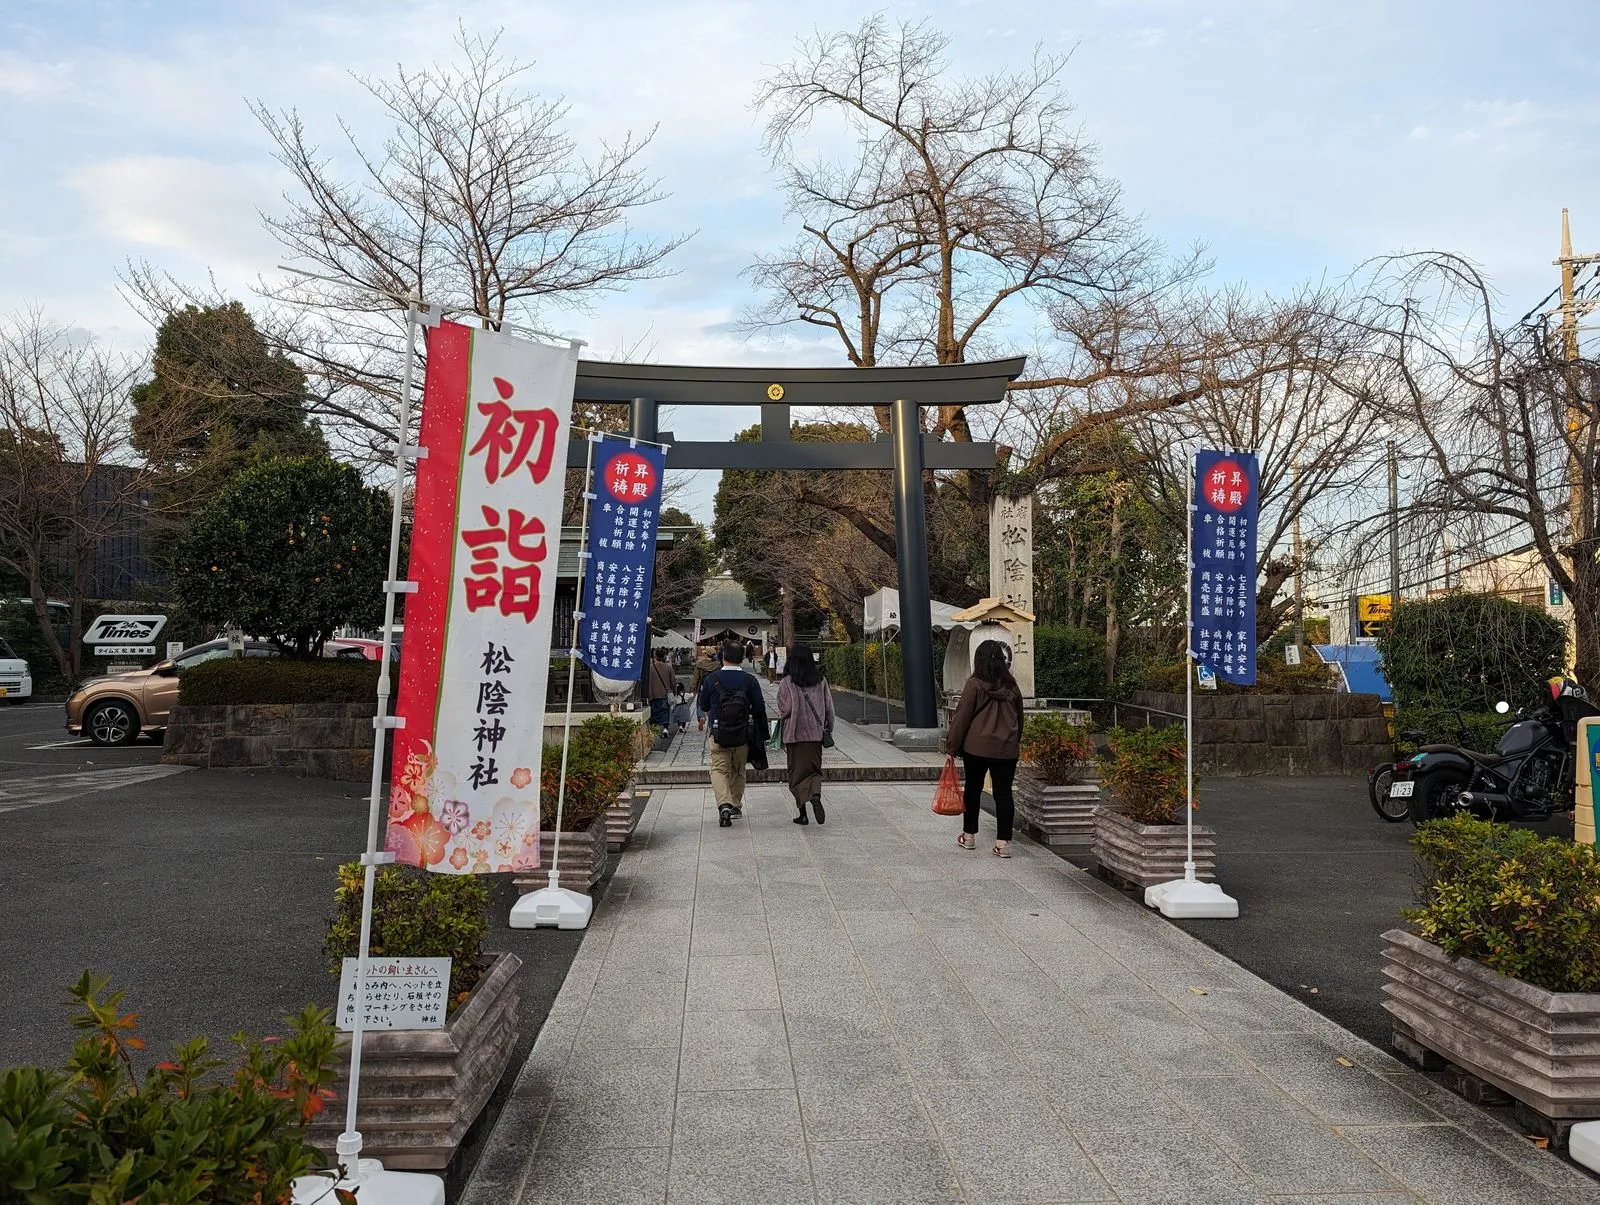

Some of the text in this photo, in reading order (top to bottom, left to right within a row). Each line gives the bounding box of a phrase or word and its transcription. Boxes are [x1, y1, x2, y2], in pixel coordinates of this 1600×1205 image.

[613, 460, 630, 495] 祈祷
[632, 463, 649, 497] 昇殿
[1229, 471, 1243, 505] 昇殿
[461, 376, 560, 624] 初詣
[611, 504, 625, 549] 合格祈願
[625, 507, 639, 551] 開運厄除
[641, 508, 653, 552] 初宮参り
[1215, 514, 1225, 559] 合格祈願
[1228, 516, 1237, 560] 開運厄除
[1238, 517, 1247, 560] 初宮参り
[594, 561, 605, 607] 商売繁盛
[604, 562, 618, 607] 安産祈願
[618, 564, 631, 608] 八方除け
[633, 565, 645, 609] 七五三参り
[1201, 571, 1211, 616] 商売繁盛
[1214, 572, 1224, 616] 安産祈願
[1226, 574, 1236, 618] 八方除け
[1238, 574, 1247, 618] 七五三参り
[97, 623, 153, 639] Times
[611, 622, 624, 668] 身体健康
[624, 622, 638, 669] 家内安全
[1211, 629, 1221, 667] 病気平
[1237, 631, 1247, 675] 家内安全
[466, 641, 516, 791] 松陰神社
[355, 964, 438, 976] ットの飼い主さんへ
[346, 1003, 441, 1013] 他マーキングをさせな
[347, 992, 442, 1001] ちらせたり、石垣その
[421, 1015, 438, 1024] 神社
